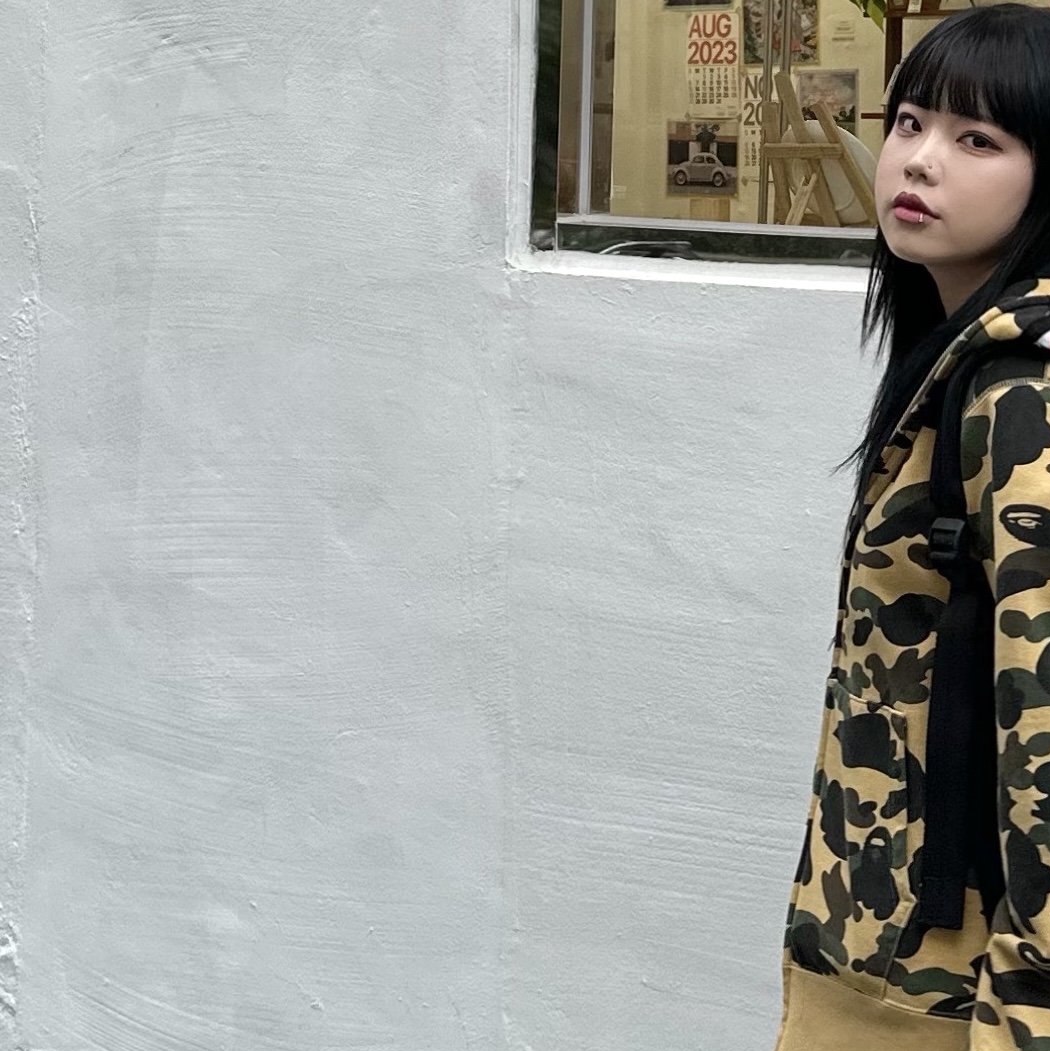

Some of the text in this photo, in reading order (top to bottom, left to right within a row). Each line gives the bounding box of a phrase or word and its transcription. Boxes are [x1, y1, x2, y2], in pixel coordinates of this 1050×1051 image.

[688, 13, 731, 38] AUG
[687, 40, 737, 65] 2023
[744, 75, 773, 99] NO
[743, 101, 763, 126] 20
